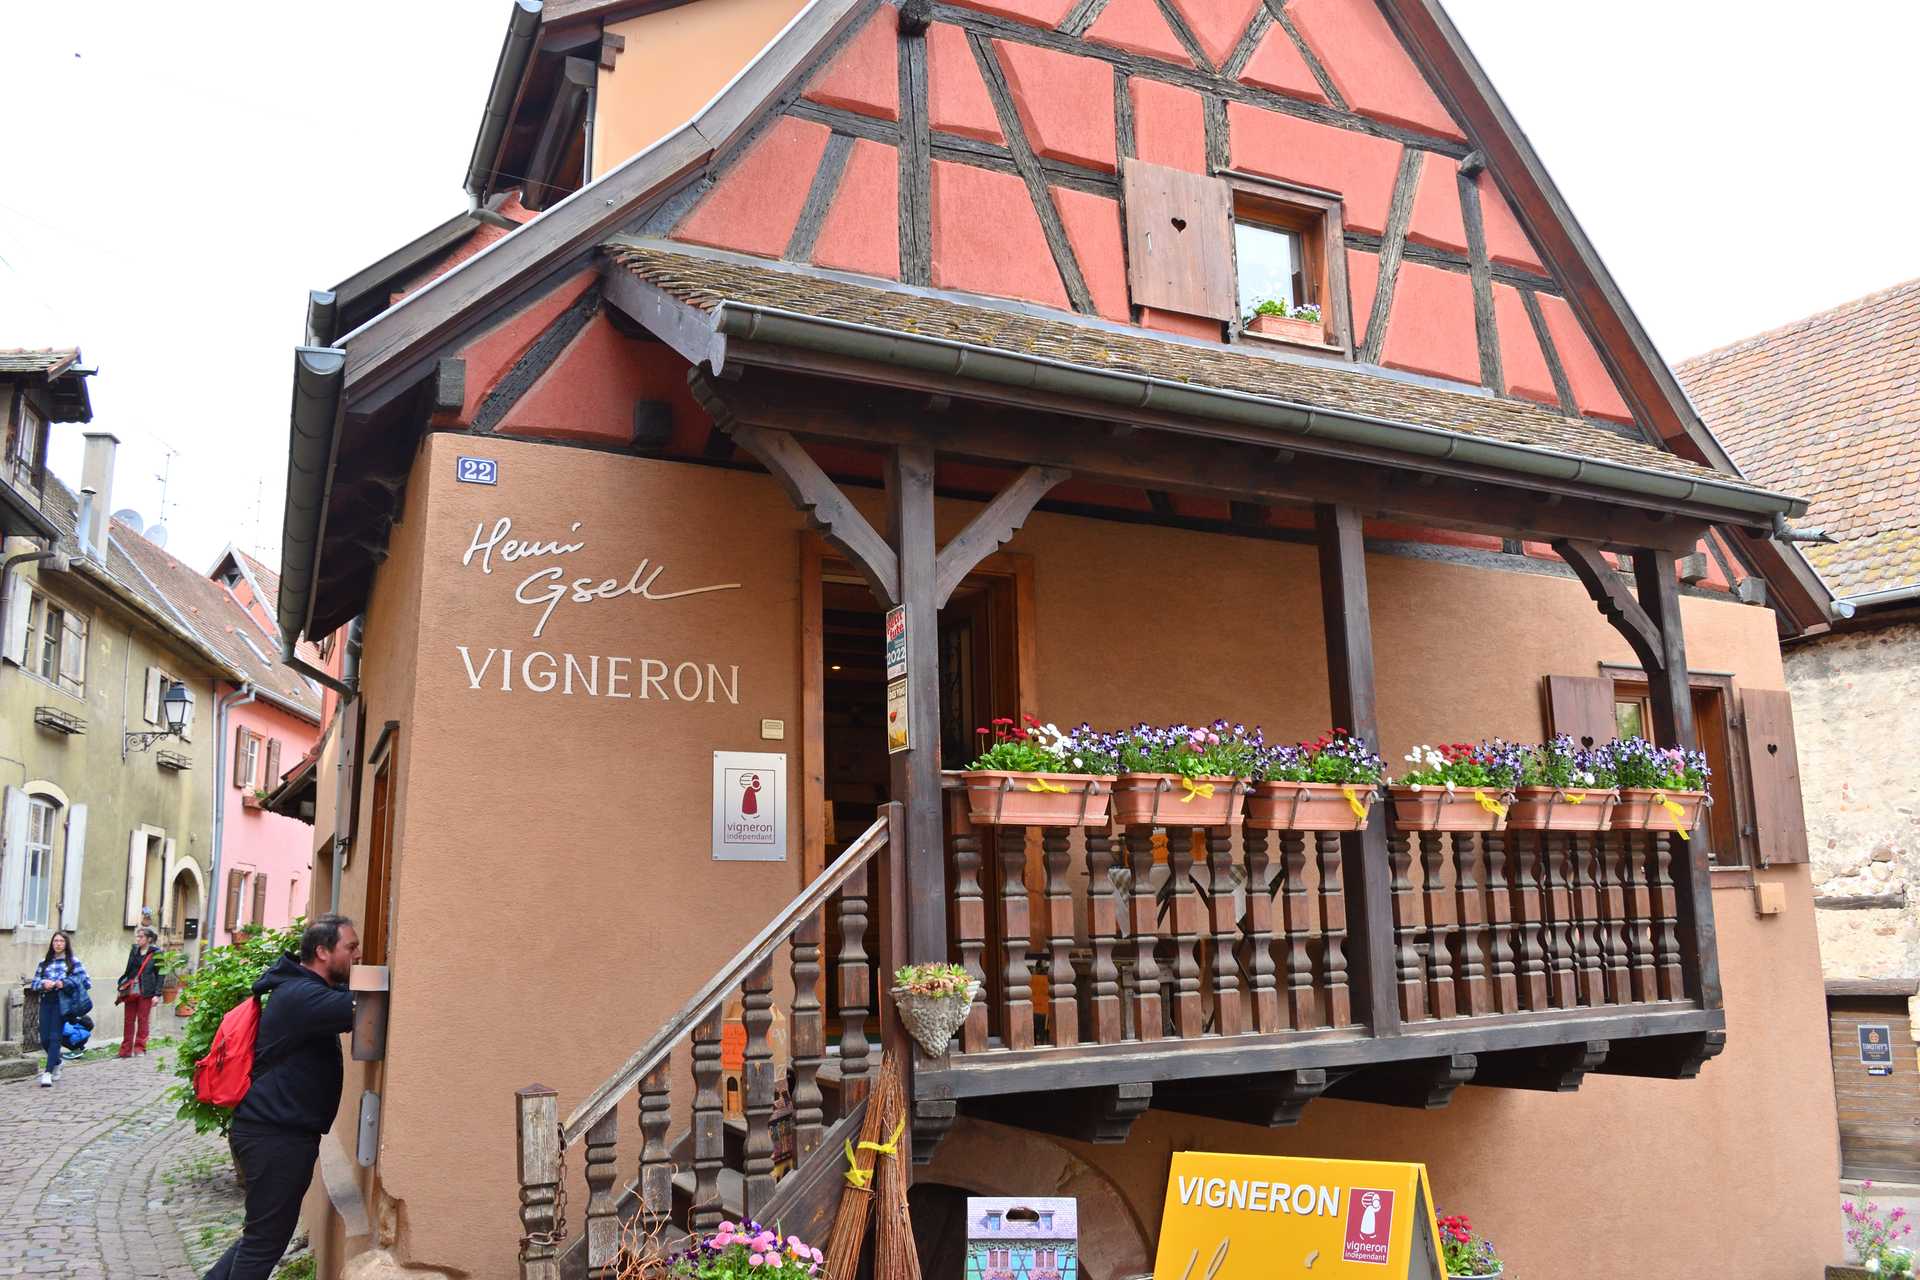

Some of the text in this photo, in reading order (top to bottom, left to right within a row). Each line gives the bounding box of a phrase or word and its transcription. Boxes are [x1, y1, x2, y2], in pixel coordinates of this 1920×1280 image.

[464, 460, 491, 481] 22
[462, 517, 585, 574] Henri
[515, 558, 742, 637] Gsell
[887, 646, 905, 665] 2022
[456, 645, 740, 704] VIGNERON
[727, 823, 773, 834] vigneron
[1178, 1175, 1341, 1217] VIGNERON
[1346, 1240, 1387, 1253] vigneron
